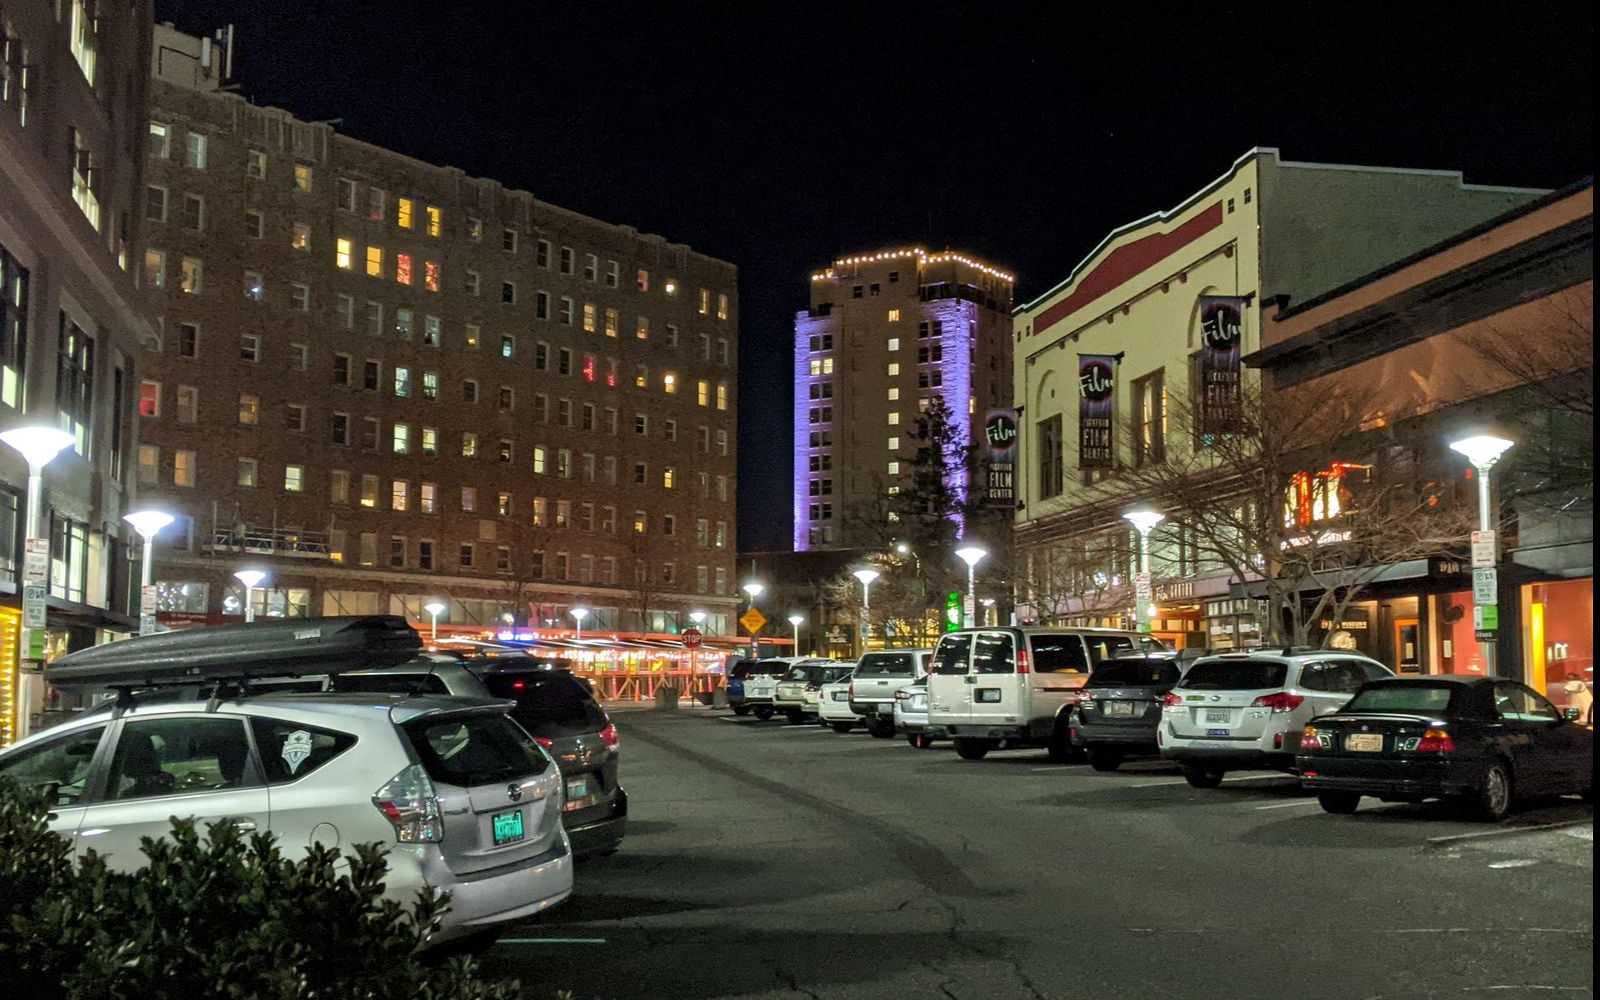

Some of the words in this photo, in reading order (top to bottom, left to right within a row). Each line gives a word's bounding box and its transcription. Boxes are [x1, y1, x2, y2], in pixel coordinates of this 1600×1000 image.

[1201, 309, 1241, 347] Film
[1079, 366, 1114, 397] Film
[985, 418, 1016, 445] Film
[1083, 429, 1109, 447] FILM
[989, 472, 1012, 488] FILM
[989, 489, 1013, 498] CENTER
[682, 634, 701, 643] STOP
